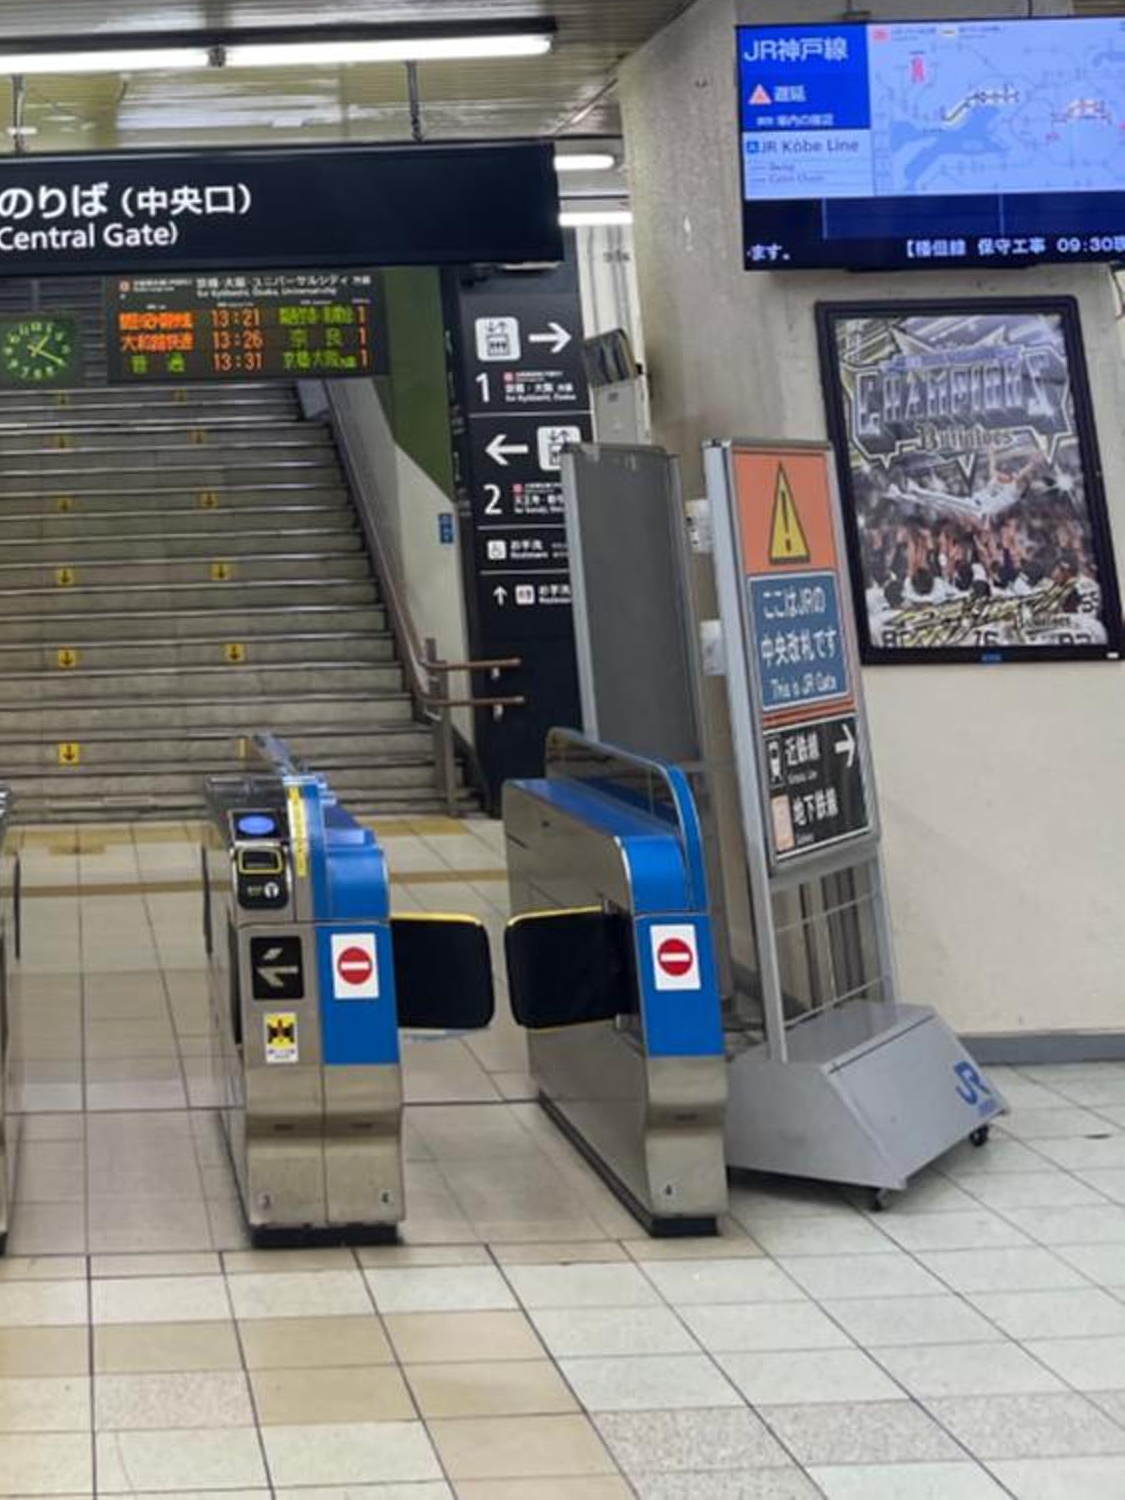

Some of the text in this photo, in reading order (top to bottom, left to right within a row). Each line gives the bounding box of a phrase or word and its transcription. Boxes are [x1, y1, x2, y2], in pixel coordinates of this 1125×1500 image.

[744, 37, 848, 62] JR神戸線
[103, 221, 179, 247] Gate)
[978, 237, 1046, 257] 保守工事
[210, 308, 262, 328] 13:21
[356, 305, 367, 323] 1
[211, 329, 263, 350] 13:26
[357, 326, 368, 346] 1
[213, 351, 264, 371] 13:31
[360, 348, 370, 368] 1
[475, 372, 490, 404] 1
[483, 483, 503, 515] 2
[762, 586, 826, 619] ここはJRの
[761, 628, 838, 668] 中央改札です
[953, 1060, 990, 1106] JR
